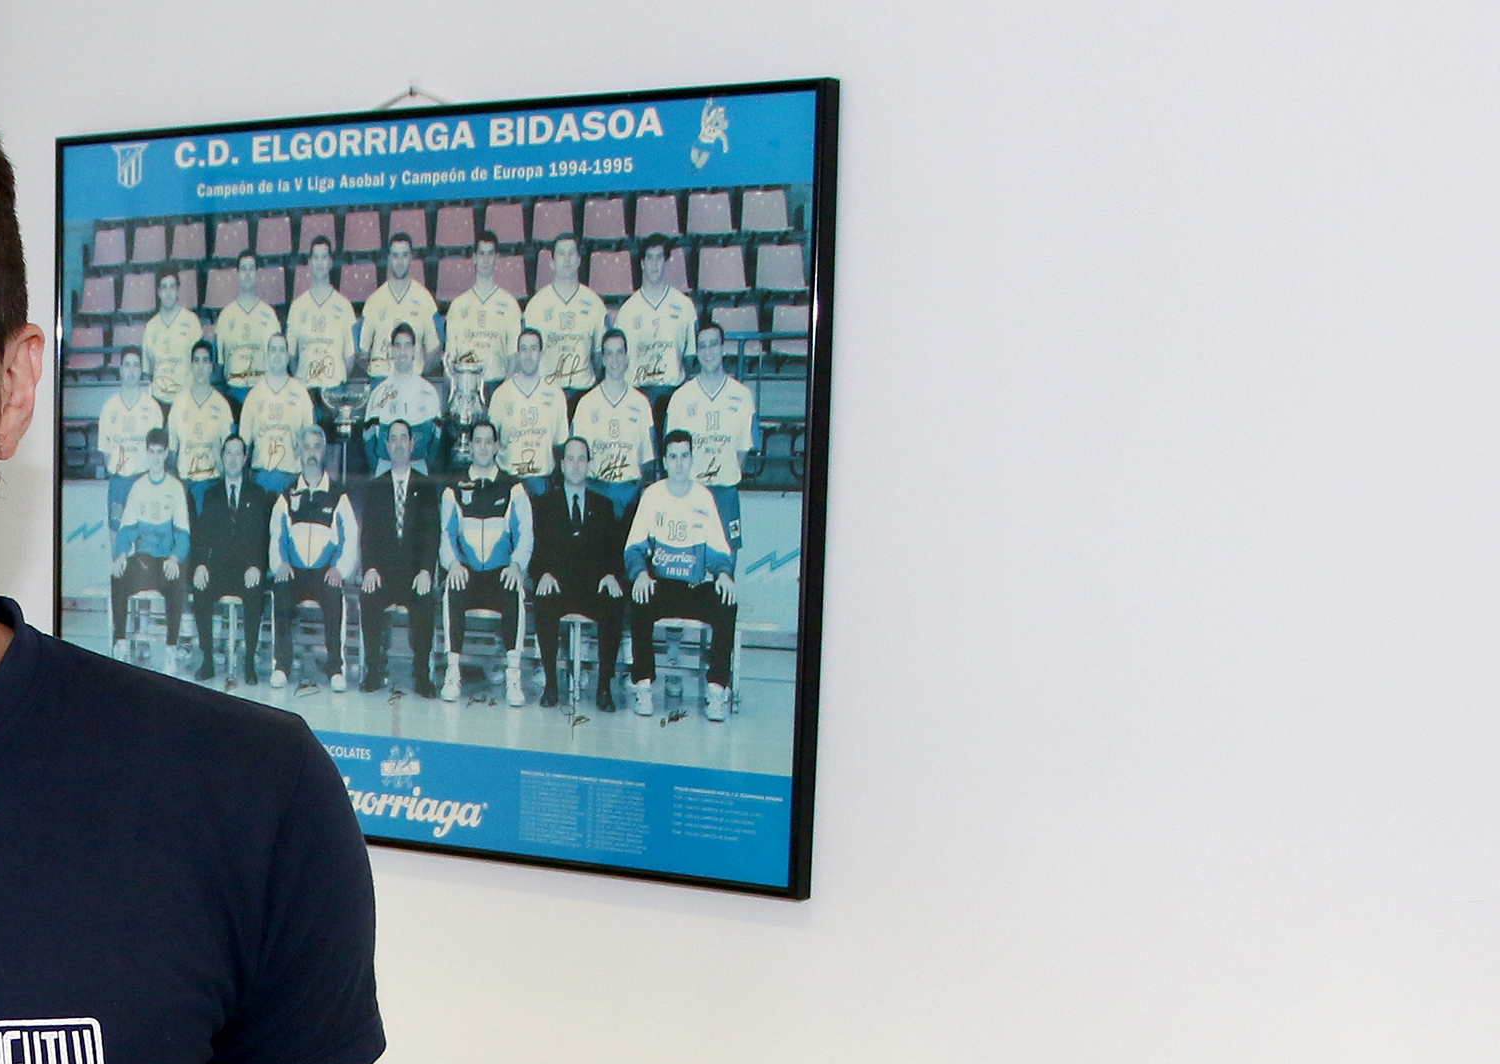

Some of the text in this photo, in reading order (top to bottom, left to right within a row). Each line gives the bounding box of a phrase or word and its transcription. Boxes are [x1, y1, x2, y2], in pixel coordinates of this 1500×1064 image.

[175, 107, 664, 168] C.D. ELGORRIAGA BIDASOA
[197, 157, 633, 198] Campeón de la V Liga Asobal y Campeón de Europa 1994-1995
[668, 520, 687, 541] 16
[323, 743, 371, 760] COLATES
